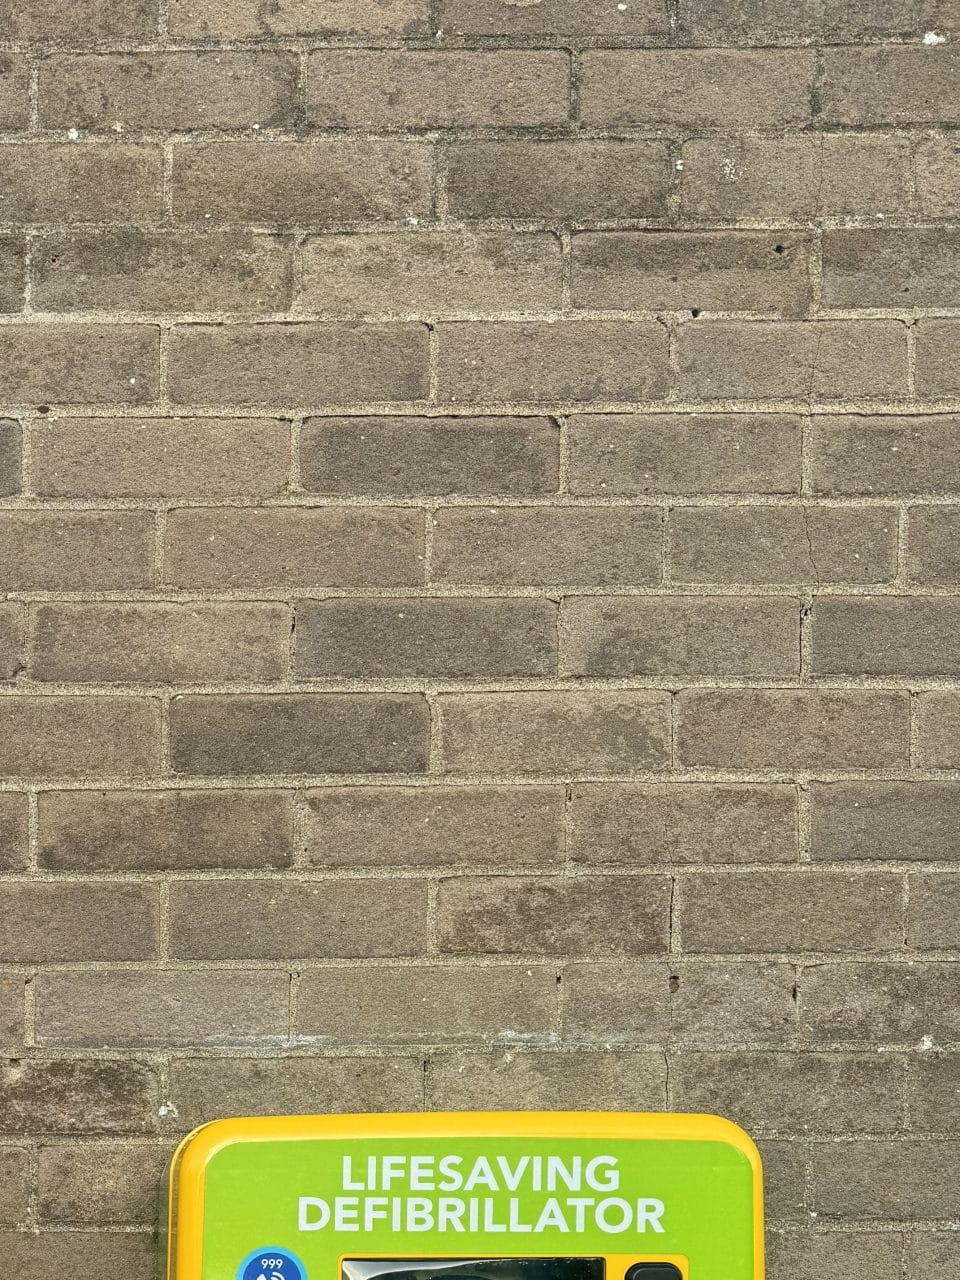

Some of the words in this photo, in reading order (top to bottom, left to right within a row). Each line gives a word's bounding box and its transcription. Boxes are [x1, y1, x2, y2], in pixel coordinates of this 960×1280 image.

[343, 1155, 619, 1192] LIFESAVING
[298, 1197, 664, 1233] DEFIBRILLATOR
[261, 1259, 283, 1268] 999
